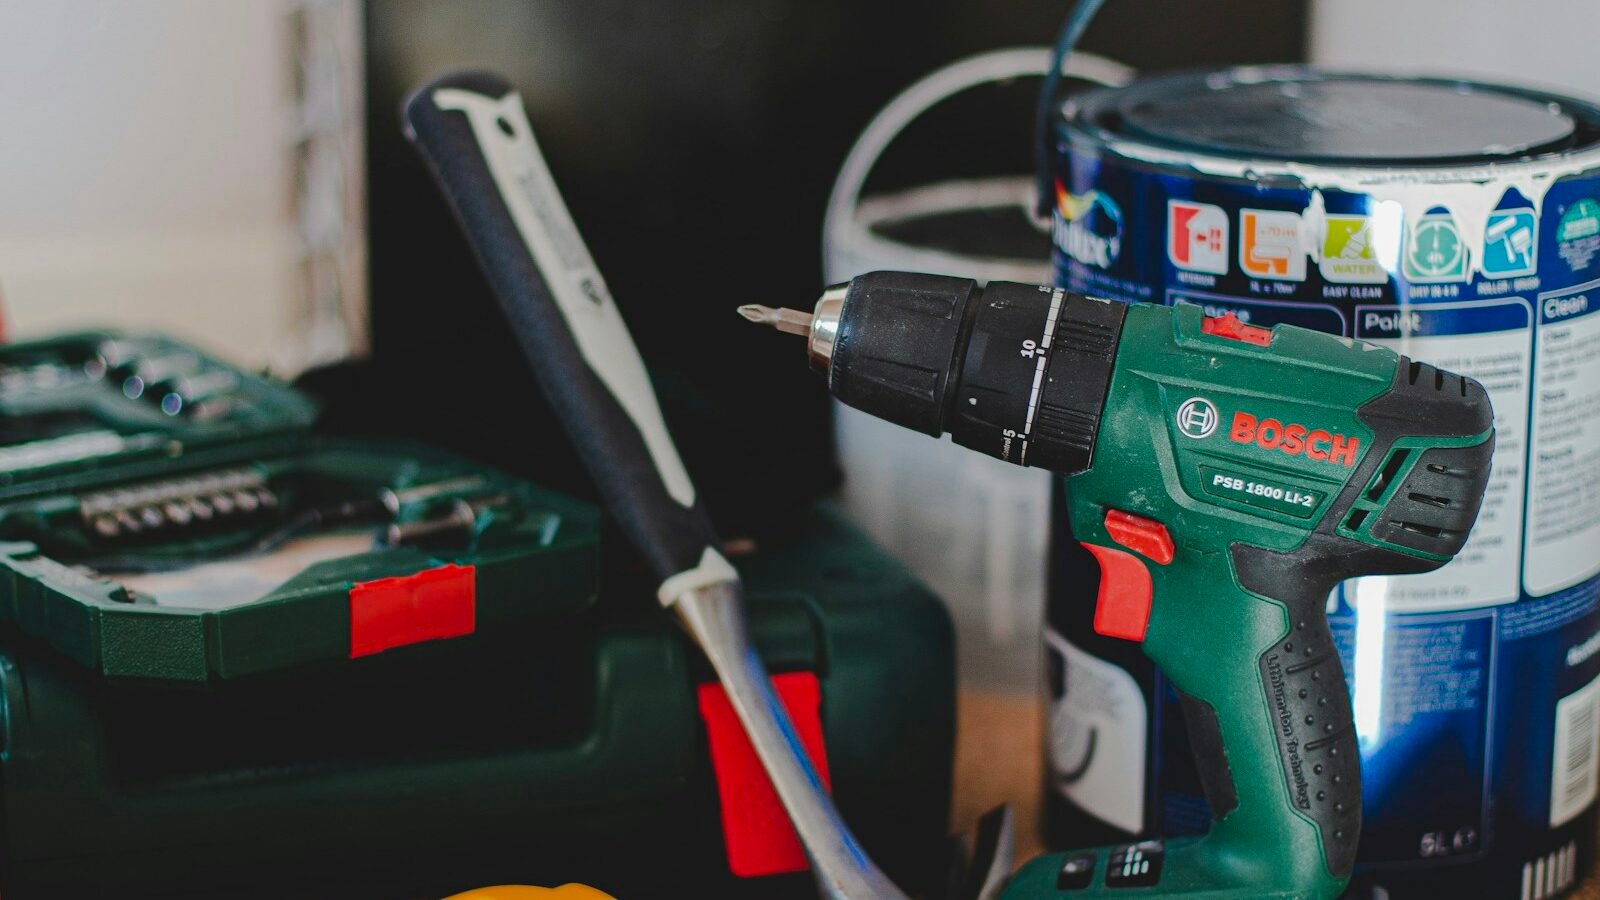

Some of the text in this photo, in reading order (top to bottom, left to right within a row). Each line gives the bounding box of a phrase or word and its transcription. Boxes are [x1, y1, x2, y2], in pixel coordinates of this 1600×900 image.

[1332, 263, 1376, 275] WATER
[1322, 285, 1382, 298] EASY CLEAN
[1544, 295, 1589, 318] Clean
[1364, 312, 1422, 332] Paint
[1020, 339, 1037, 359] 10
[1003, 428, 1016, 438] 5
[1228, 411, 1360, 468] BOSCH
[1212, 474, 1315, 508] PSB 1800 LI-2
[1285, 737, 1312, 811] Technology
